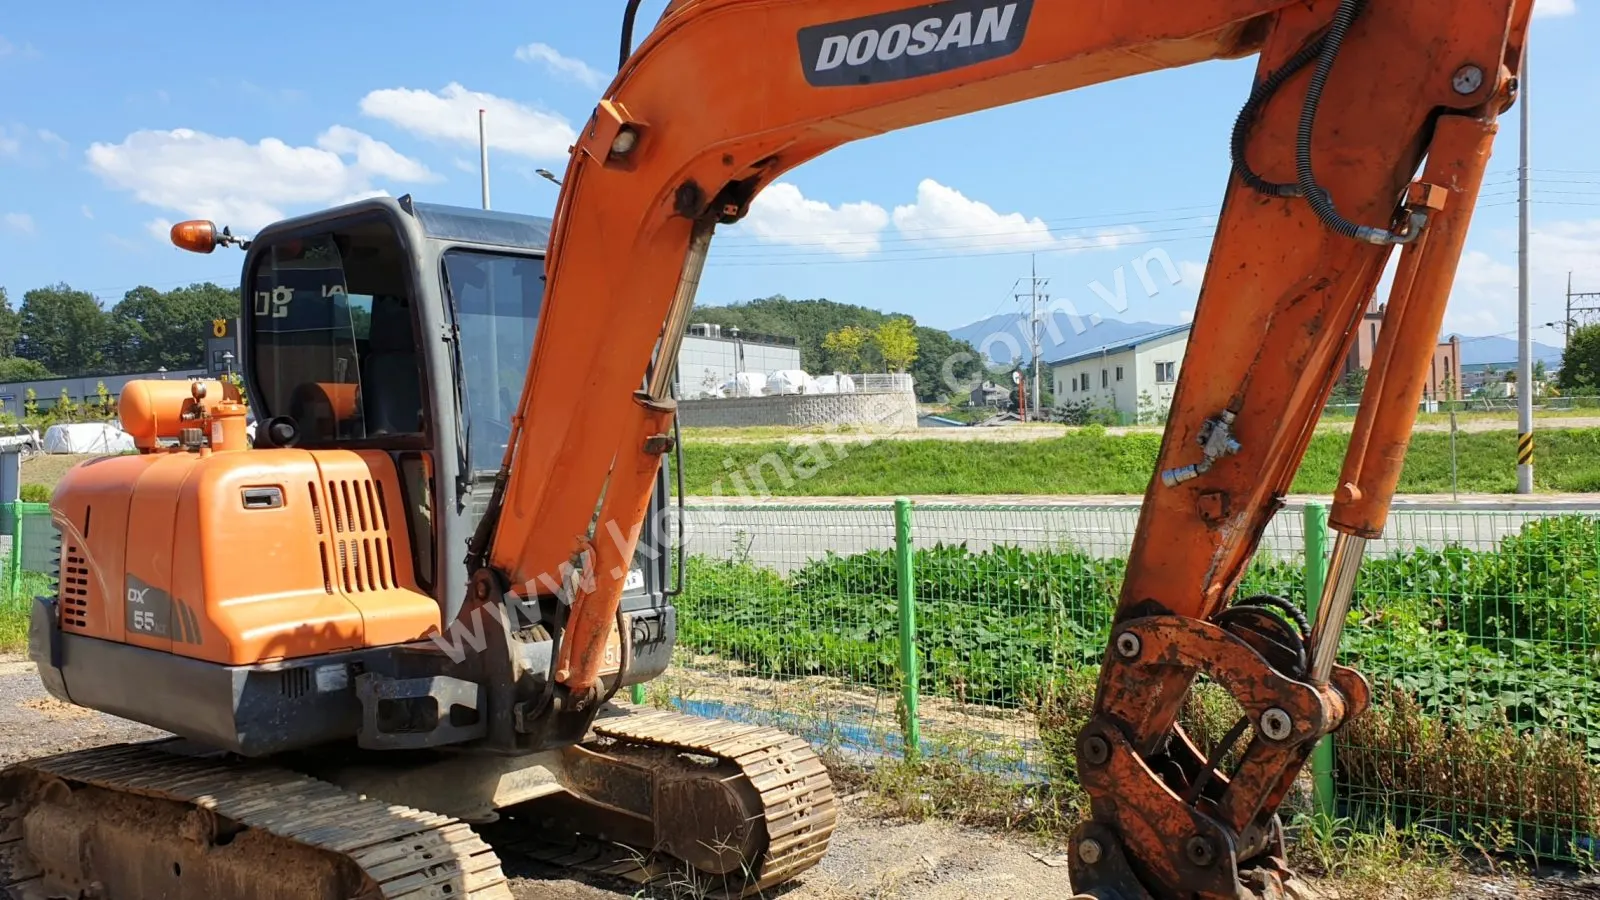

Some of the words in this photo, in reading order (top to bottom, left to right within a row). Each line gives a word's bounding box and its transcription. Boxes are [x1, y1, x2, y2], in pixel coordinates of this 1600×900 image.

[815, 3, 1017, 71] DOOSAN
[127, 588, 150, 604] DX
[134, 610, 154, 631] 55
